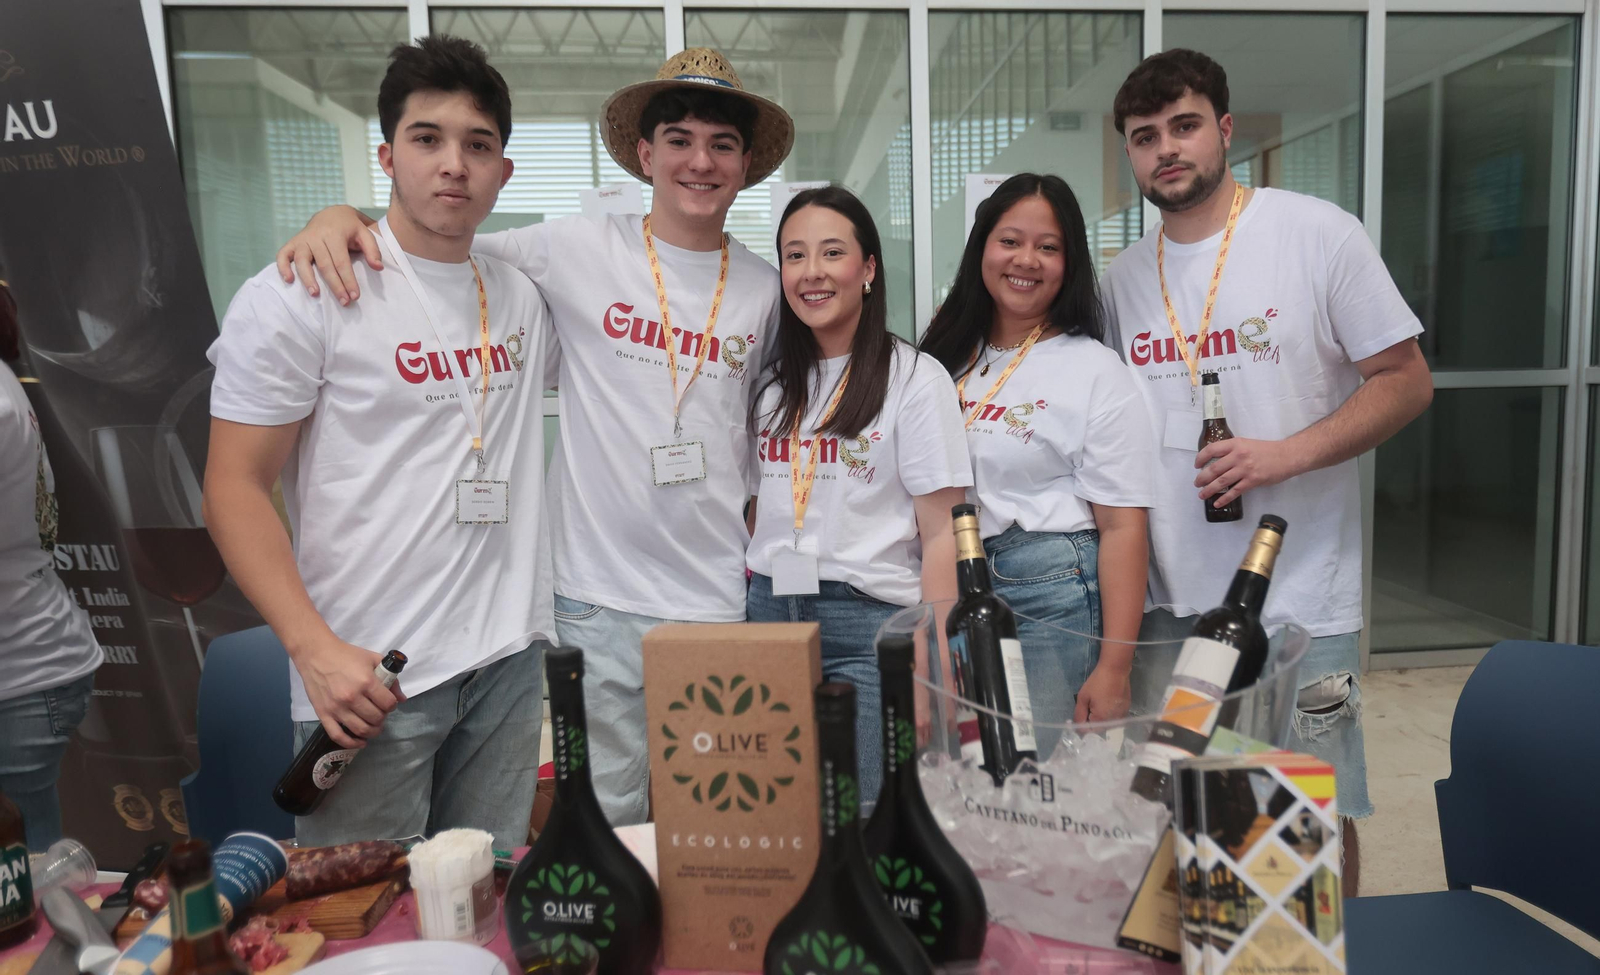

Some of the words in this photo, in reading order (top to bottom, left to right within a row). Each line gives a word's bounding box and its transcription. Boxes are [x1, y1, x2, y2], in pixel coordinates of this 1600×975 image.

[20, 153, 57, 171] THE
[615, 350, 635, 360] Que
[1148, 374, 1162, 382] Que
[1217, 365, 1227, 373] de
[425, 394, 446, 403] Que
[51, 544, 120, 571] STAU
[82, 587, 130, 606] India
[965, 797, 1038, 827] CAYETANO
[1061, 816, 1100, 837] PINO
[672, 834, 802, 849] ECOLOGIC
